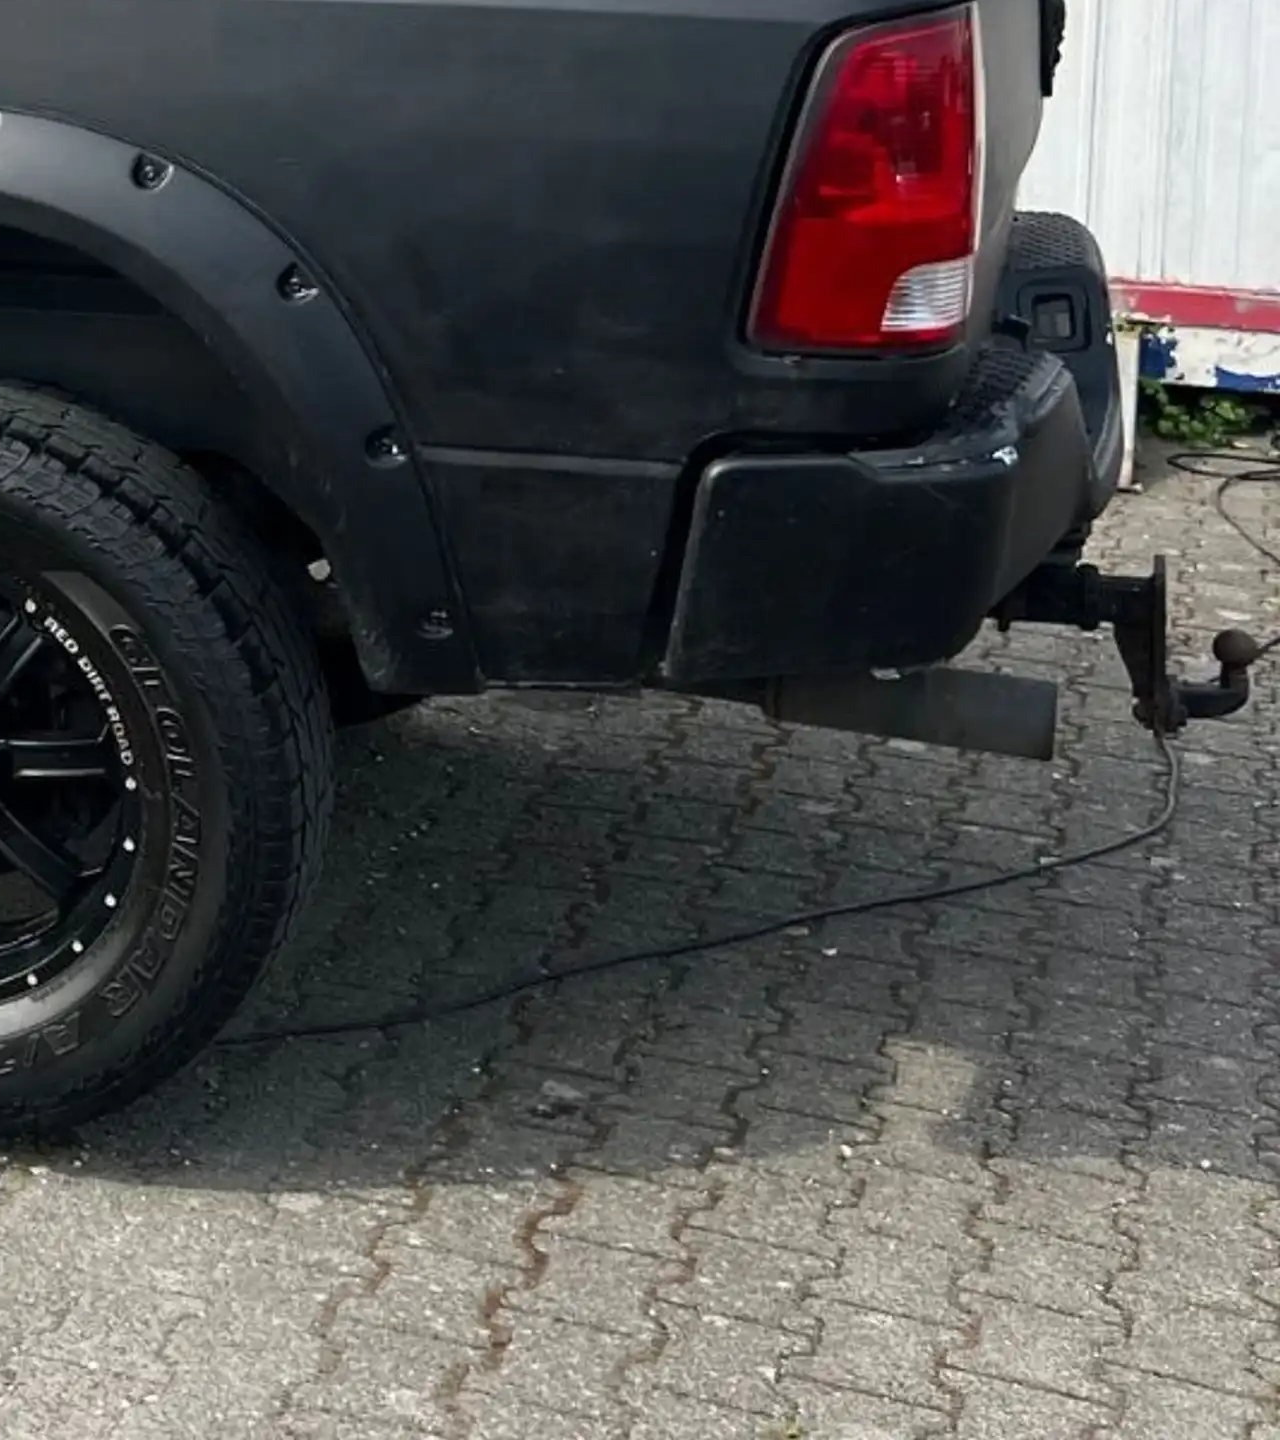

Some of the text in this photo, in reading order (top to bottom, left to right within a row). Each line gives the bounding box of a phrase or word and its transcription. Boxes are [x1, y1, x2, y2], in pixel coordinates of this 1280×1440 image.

[43, 615, 135, 766] RED DIRT ROAD
